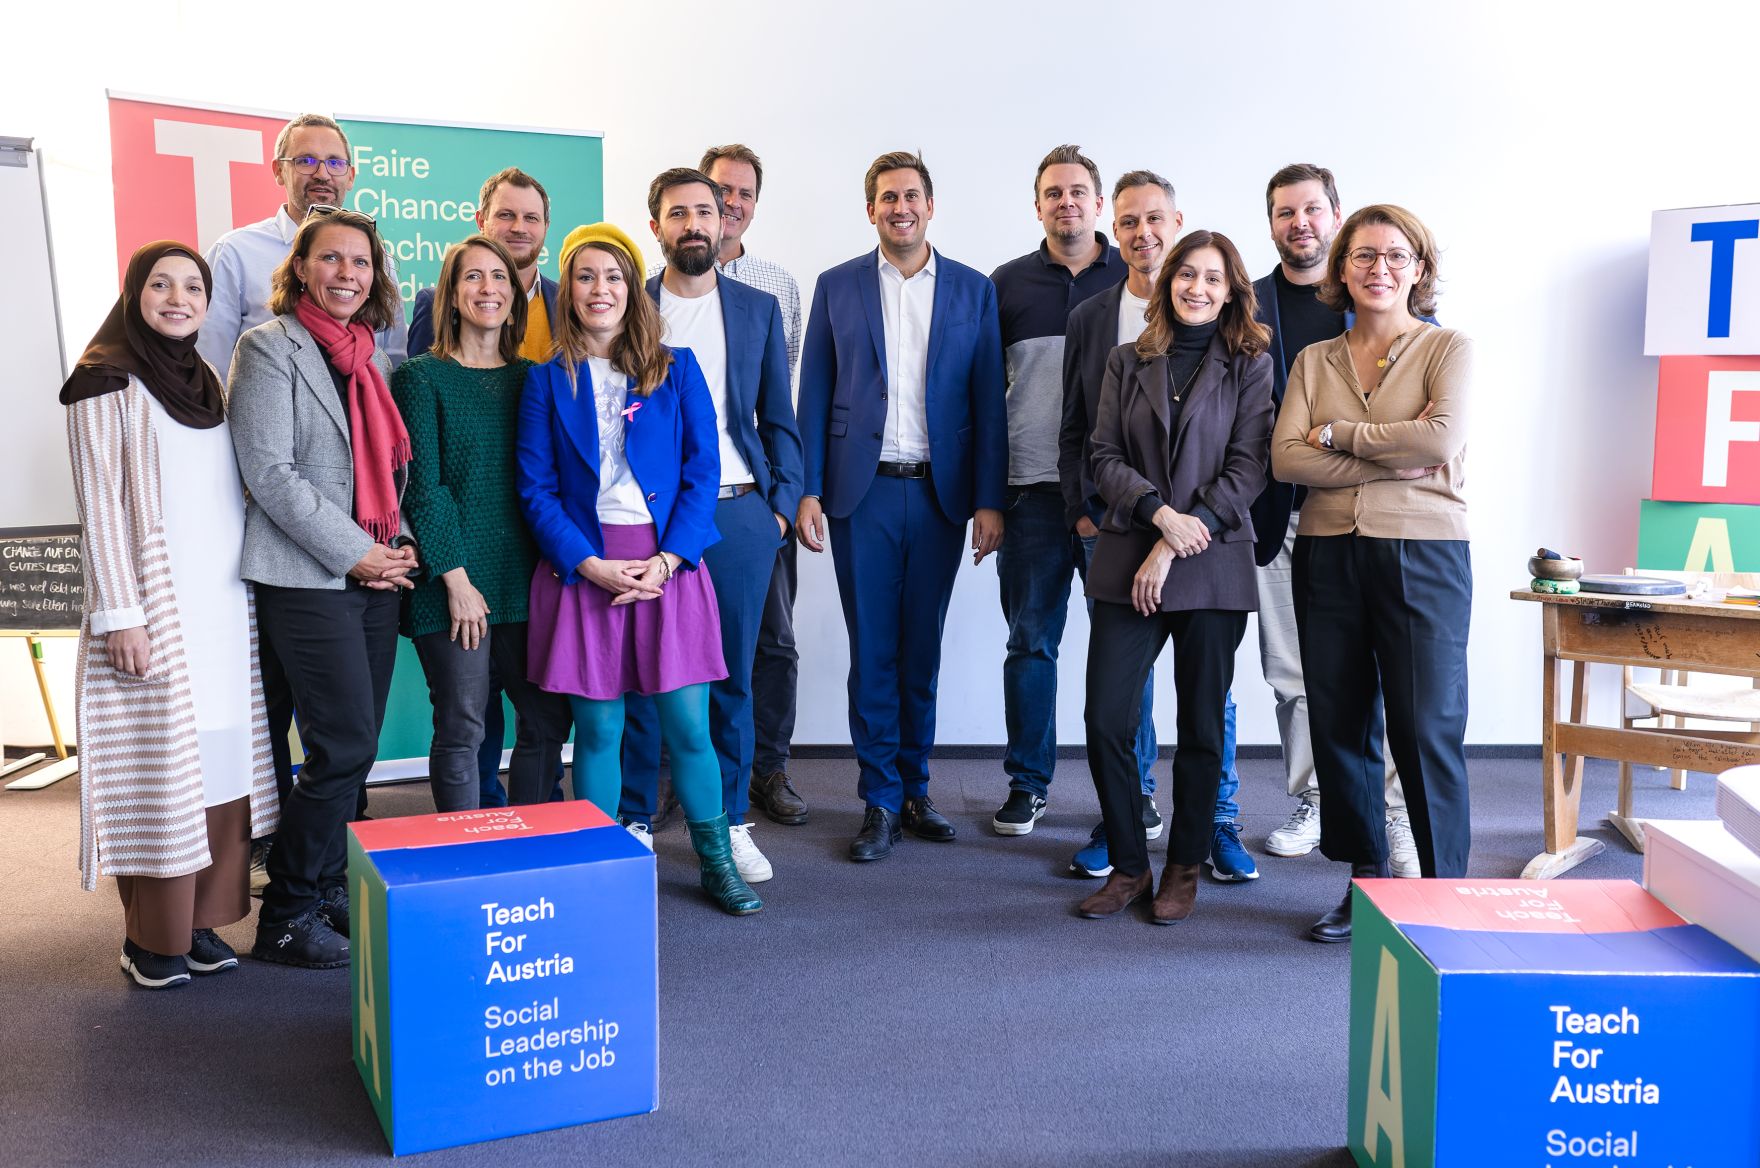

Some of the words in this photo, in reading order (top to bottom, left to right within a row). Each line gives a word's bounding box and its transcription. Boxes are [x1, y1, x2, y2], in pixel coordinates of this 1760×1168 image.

[353, 145, 431, 179] Faire
[154, 118, 264, 256] T
[1691, 219, 1760, 338] T
[1702, 370, 1760, 488] F
[9, 561, 45, 572] GUTES
[44, 546, 63, 559] AUF
[436, 810, 516, 823] Austria
[463, 822, 534, 834] Teach
[486, 816, 524, 824] For
[1455, 886, 1549, 899] Austria
[1519, 899, 1565, 911] For
[480, 896, 556, 927] Teach
[1495, 910, 1582, 923] Teach
[485, 931, 527, 956] For
[485, 952, 575, 986] Austria
[359, 875, 382, 1101] A
[484, 996, 559, 1030] Social
[1548, 1005, 1640, 1035] Teach
[484, 1018, 620, 1059] Leadership
[485, 1065, 516, 1087] on
[522, 1056, 563, 1081] the
[570, 1045, 616, 1073] Job
[1363, 944, 1406, 1168] A
[1552, 1039, 1604, 1070] For
[1549, 1074, 1661, 1105] Austria
[1545, 1128, 1638, 1158] Social
